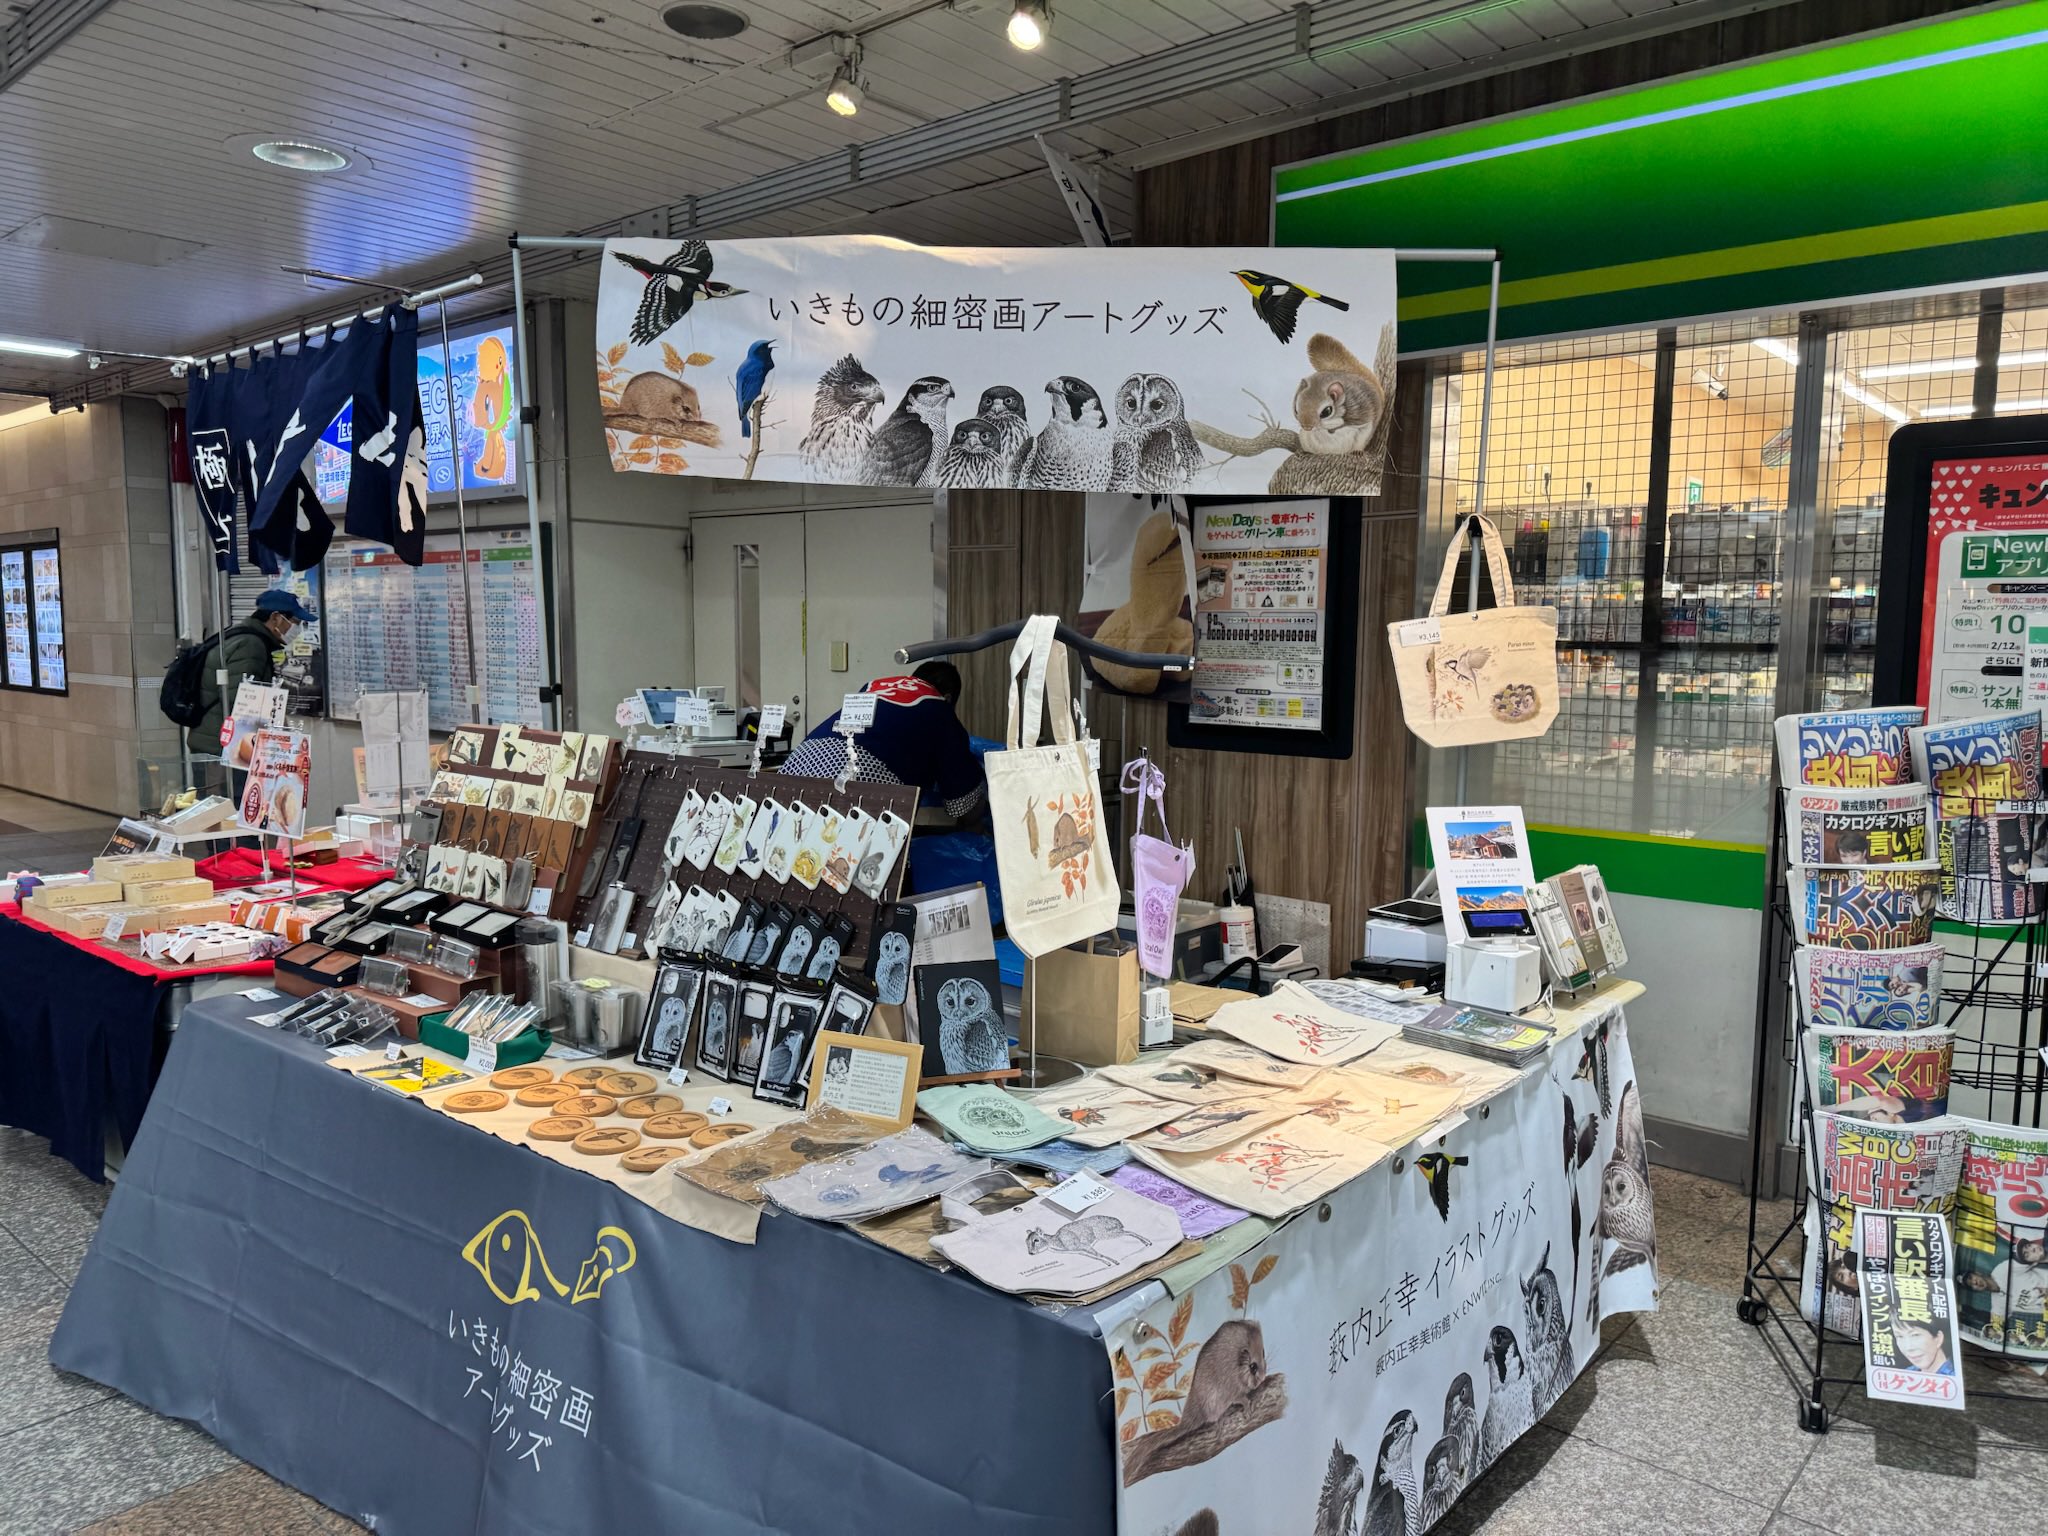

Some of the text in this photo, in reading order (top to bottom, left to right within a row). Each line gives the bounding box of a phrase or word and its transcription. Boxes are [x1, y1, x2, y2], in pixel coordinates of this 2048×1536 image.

[768, 291, 1229, 338] いきもの細密画アートグッズ
[1982, 699, 2022, 710] 1本無
[1837, 1131, 1917, 1164] WBC
[1425, 1181, 1537, 1299] イラストグッズ
[1893, 1217, 1932, 1324] 言い訳番長
[1928, 1218, 1948, 1319] カタログギフト配布
[449, 1309, 594, 1438] いきもの細密画
[463, 1366, 553, 1473] アートグッズ
